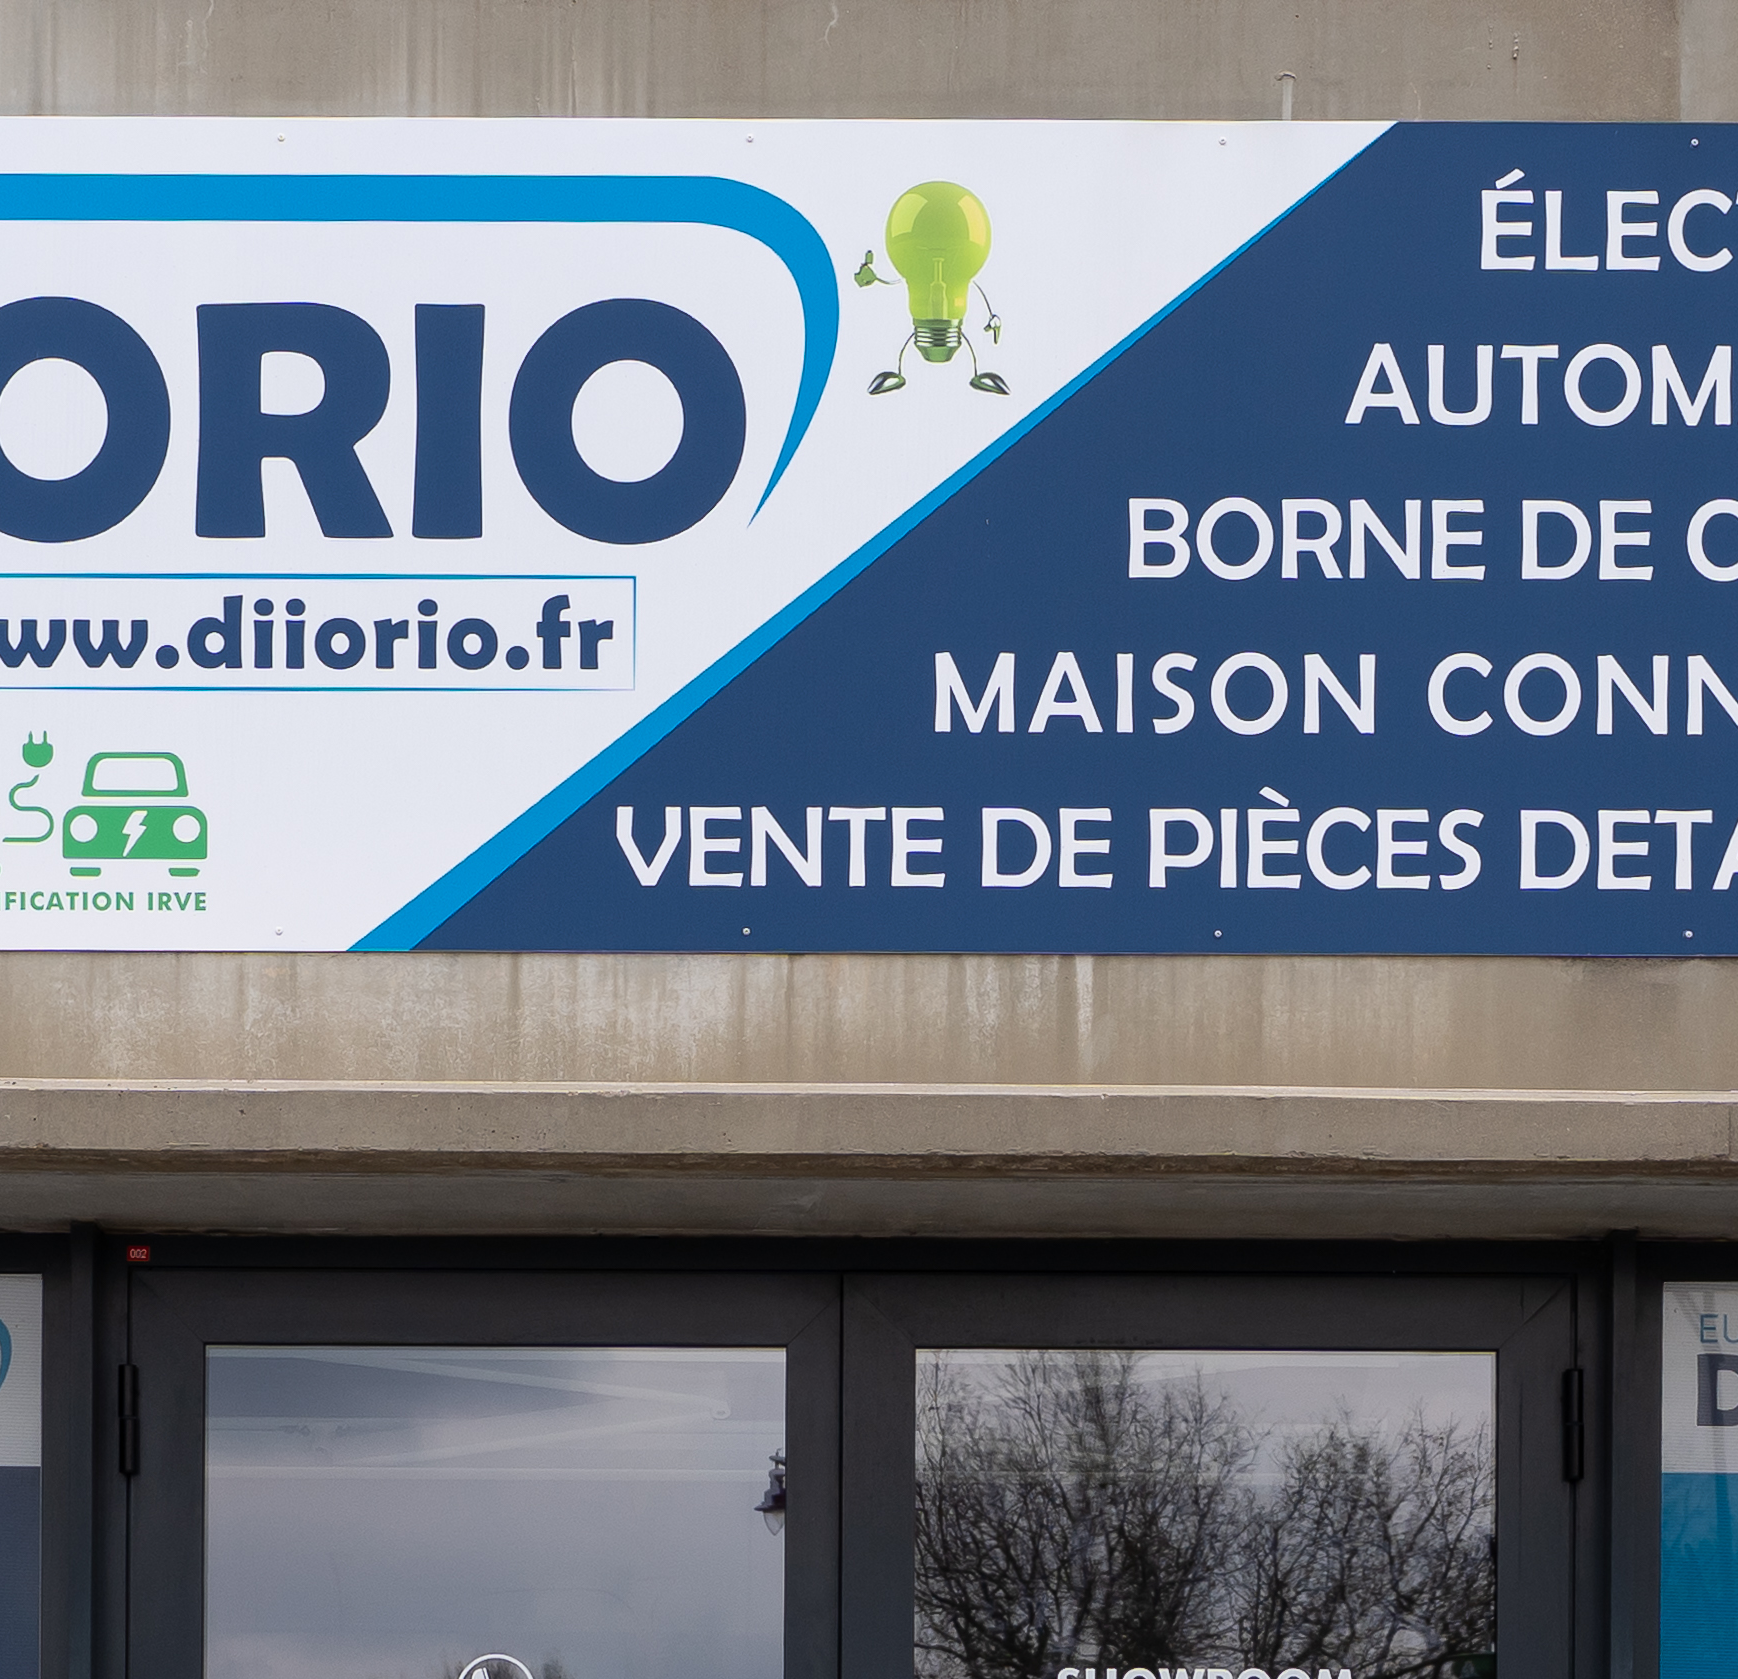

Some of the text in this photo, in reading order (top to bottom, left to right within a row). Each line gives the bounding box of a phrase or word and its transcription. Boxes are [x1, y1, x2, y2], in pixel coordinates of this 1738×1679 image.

[1130, 499, 1484, 582] BORNE
[1524, 501, 1650, 582] DE
[936, 650, 1373, 736] MAISON
[616, 807, 946, 888] VENTE
[982, 807, 1111, 889] DE
[1151, 788, 1484, 892] PIÈCES
[146, 890, 207, 913] IRVE
